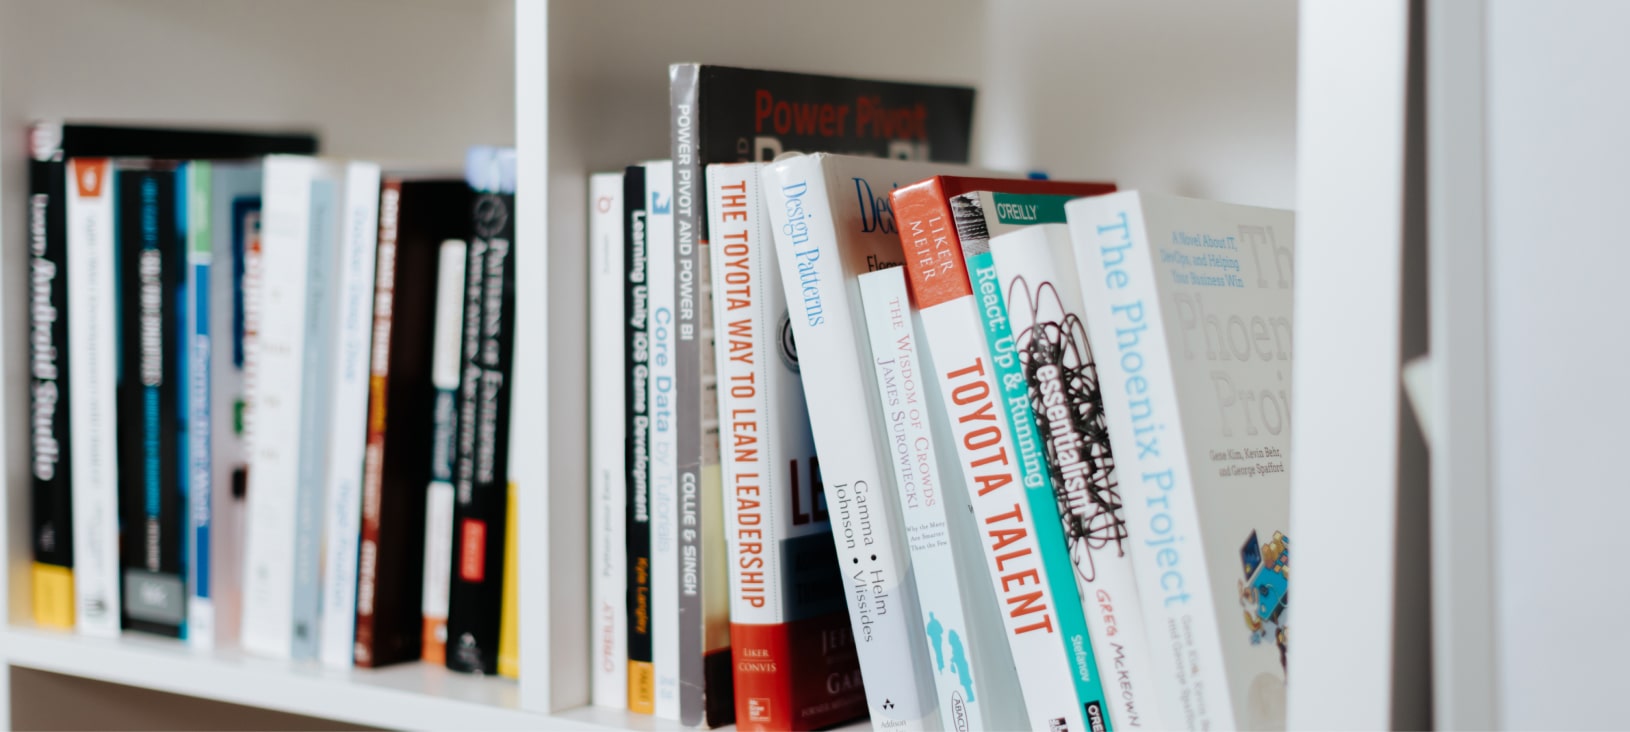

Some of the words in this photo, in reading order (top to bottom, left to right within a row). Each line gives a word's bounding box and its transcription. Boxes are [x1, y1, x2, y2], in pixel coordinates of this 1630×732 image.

[678, 104, 690, 164] POWER
[755, 89, 850, 136] Power
[856, 96, 927, 139] Pivot
[678, 170, 691, 216] PIVOT
[721, 180, 746, 222] THE
[782, 181, 812, 246] Design
[997, 203, 1038, 221] O'REILLY
[631, 211, 646, 282] Learning
[679, 220, 691, 256] AND
[910, 220, 935, 281] MEIER
[928, 215, 954, 273] LIKER
[1097, 212, 1133, 290] The
[1203, 234, 1225, 249] About
[1208, 254, 1240, 271] Helping
[1238, 224, 1293, 289] Th
[679, 262, 692, 320] POWER
[723, 229, 750, 310] TOYOTA
[796, 247, 825, 327] Patterns
[1225, 273, 1244, 288] Win
[631, 286, 648, 329] Unity
[976, 265, 1005, 332] React:
[633, 333, 648, 362] iOS
[655, 307, 671, 367] Core
[681, 323, 693, 340] BI
[728, 319, 753, 369] WAY
[994, 334, 1014, 368] Up
[1174, 292, 1293, 361] Phoen
[634, 365, 648, 413] Game
[656, 377, 672, 432] Data
[731, 372, 756, 399] TO
[888, 297, 904, 329] THE
[896, 334, 918, 405] WISDOM
[909, 409, 921, 429] OF
[915, 436, 936, 507] CROWDS
[1003, 372, 1022, 391] &
[1111, 300, 1165, 460] Phoenix
[657, 442, 670, 466] by
[732, 408, 758, 463] LEAN
[877, 357, 898, 406] JAMES
[891, 411, 919, 509] SUROWIECKI
[1009, 394, 1044, 488] Running
[1037, 363, 1094, 518] essentialism
[633, 416, 649, 522] Development
[947, 357, 1014, 496] TOYOTA
[985, 503, 1054, 635] TALENT
[657, 472, 672, 552] Tutorials
[683, 472, 695, 526] COLLIE
[683, 531, 695, 540] &
[735, 473, 765, 608] LEADERSHIP
[854, 480, 874, 547] Gamma
[870, 569, 888, 616] Helm
[906, 525, 918, 533] Why
[911, 544, 926, 552] Than
[1142, 468, 1192, 608] Project
[683, 544, 697, 595] SINGH
[834, 483, 856, 549] Johnson
[853, 570, 873, 643] Vlissides
[1096, 588, 1118, 638] GREG
[739, 662, 777, 672] CONVIS
[744, 647, 769, 657] LIKER
[1071, 634, 1090, 681] Stefanov
[954, 698, 966, 732] ABACU
